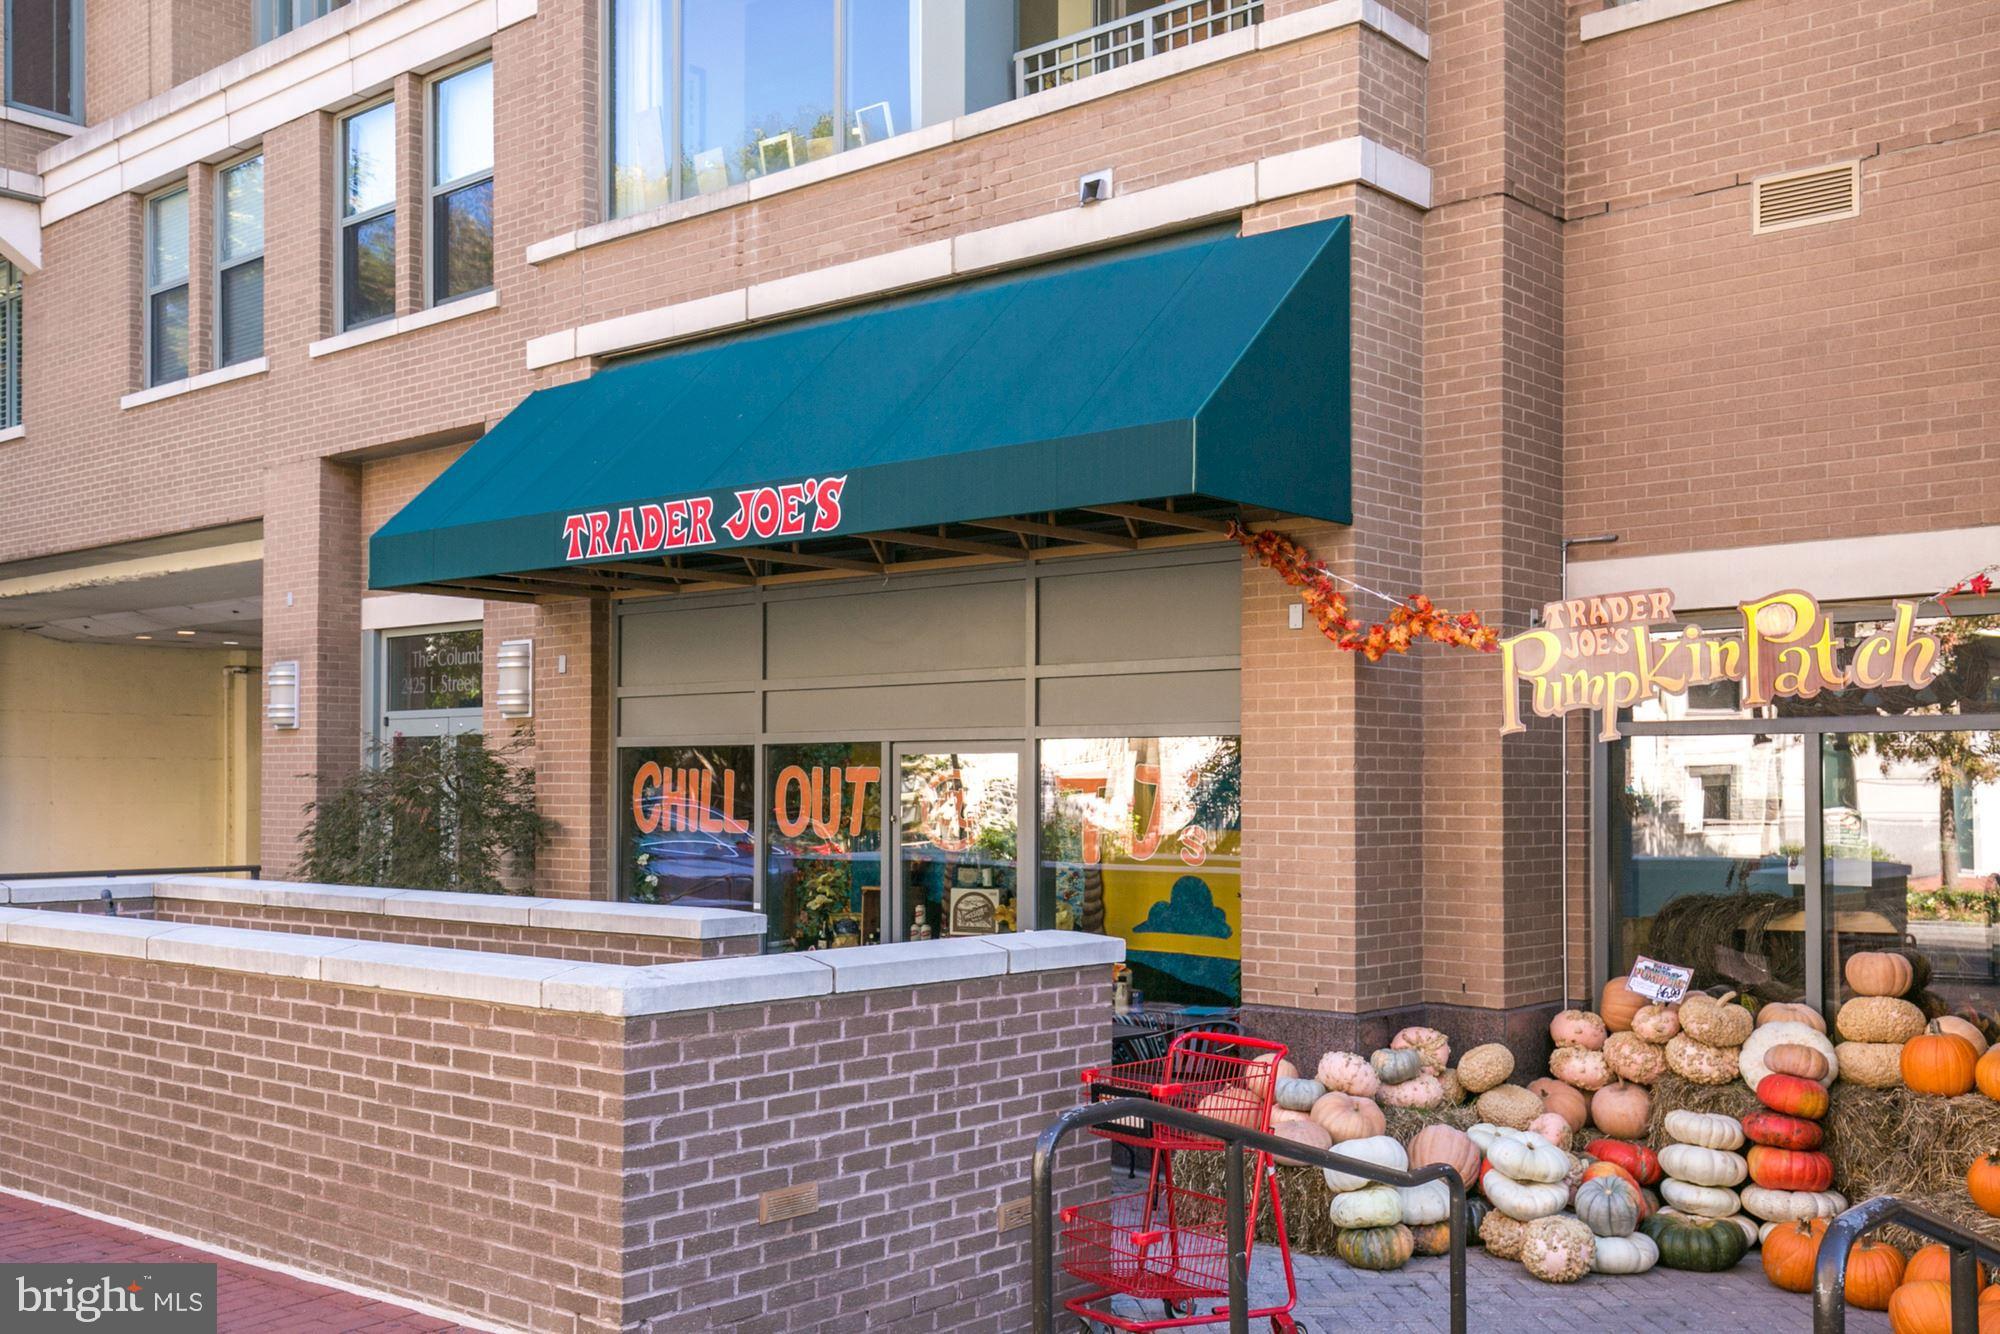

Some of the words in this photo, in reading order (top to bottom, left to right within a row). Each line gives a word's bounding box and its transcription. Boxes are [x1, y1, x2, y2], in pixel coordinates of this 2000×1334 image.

[562, 497, 716, 561] TRADER
[721, 474, 848, 541] JOE'S
[1545, 591, 1671, 630] TRADER
[411, 650, 433, 668] The
[1563, 627, 1630, 659] JOE'S
[401, 676, 426, 695] 2425
[430, 676, 437, 693] L
[441, 674, 478, 693] Street
[1499, 625, 1741, 741] Pumpkin
[1741, 592, 1935, 705] Patch
[632, 760, 749, 834] CHILL
[774, 765, 880, 838] OUT
